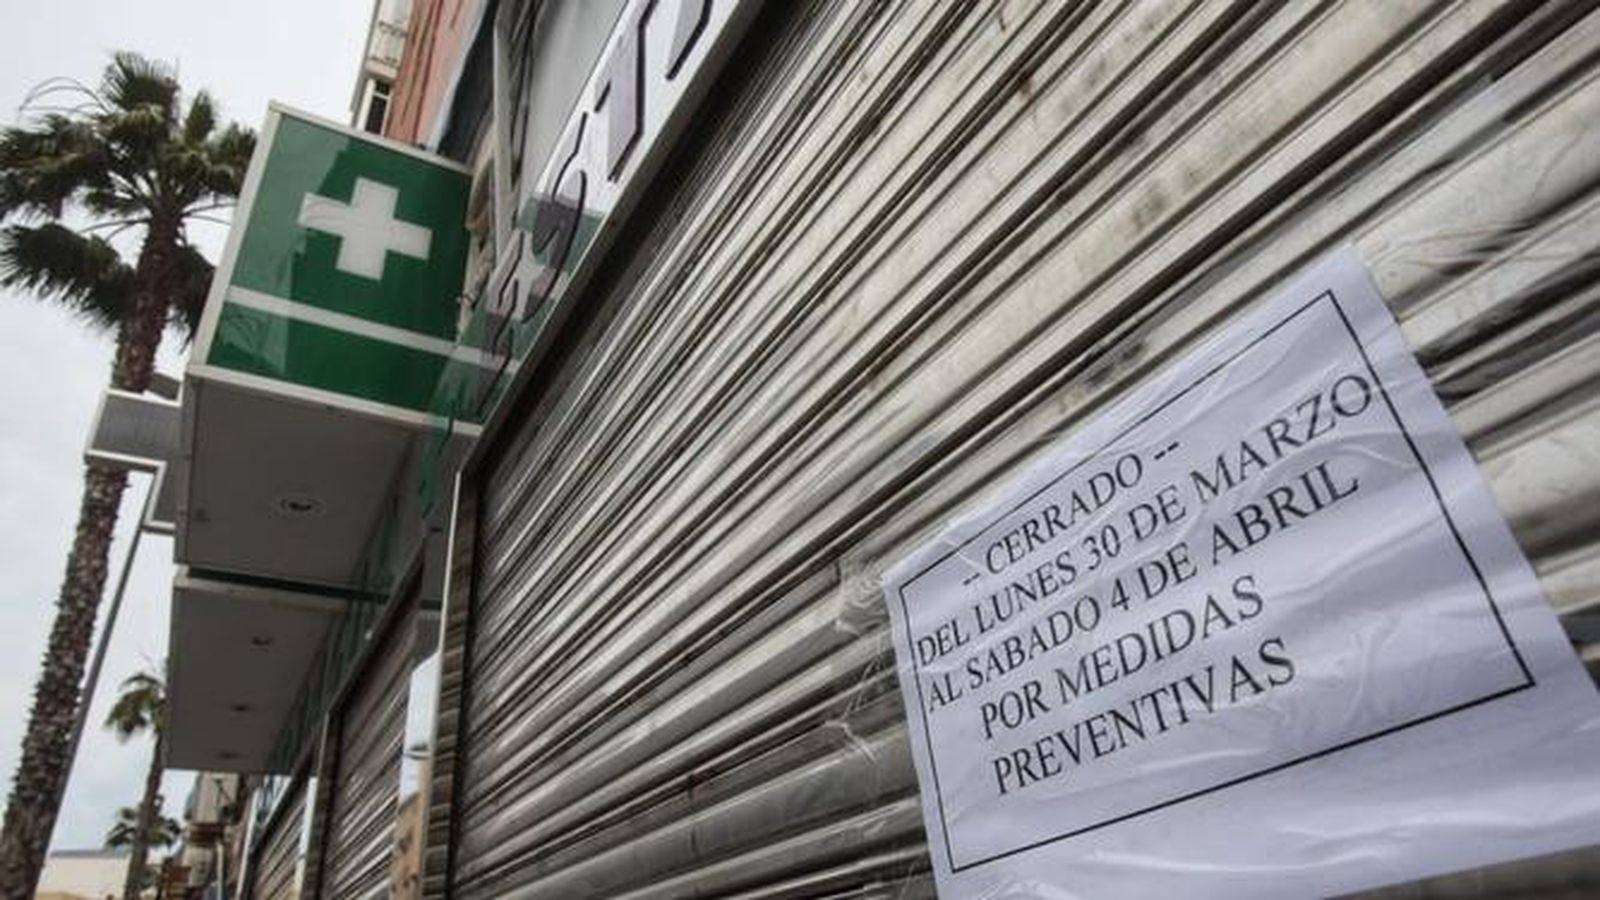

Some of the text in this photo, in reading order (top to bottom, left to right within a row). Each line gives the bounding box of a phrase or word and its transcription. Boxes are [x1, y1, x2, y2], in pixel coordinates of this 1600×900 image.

[917, 374, 1373, 666] DEL LUNES 30 DE MARZO
[928, 461, 1358, 712] AL SABADO 4 DE ABRIL
[985, 453, 1143, 575] CERRADO
[979, 576, 1264, 739] POR MEDIDAS
[993, 637, 1295, 795] PREVENTIVAS
